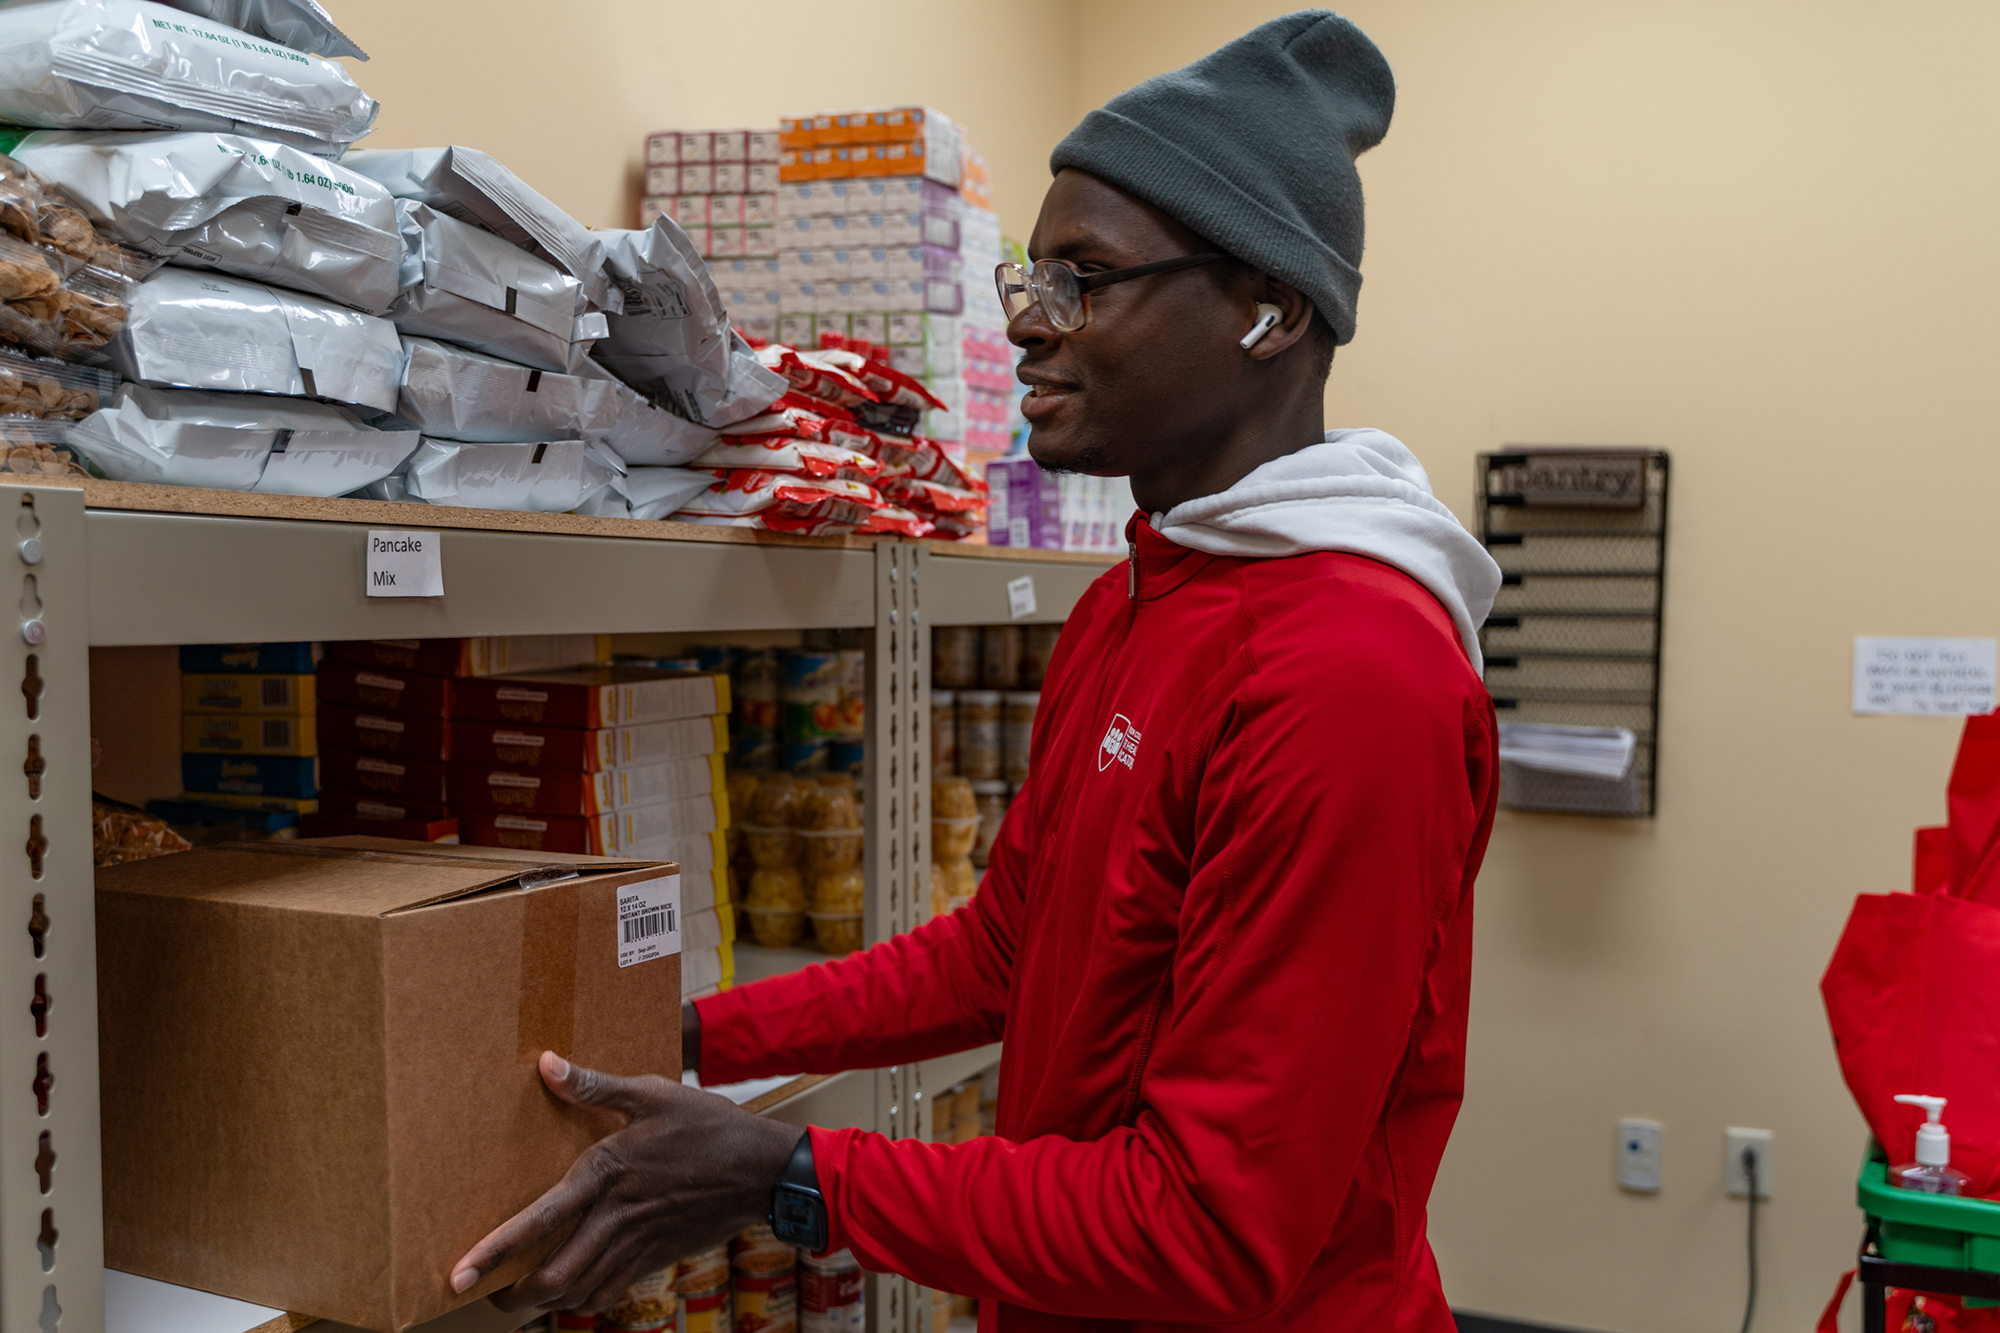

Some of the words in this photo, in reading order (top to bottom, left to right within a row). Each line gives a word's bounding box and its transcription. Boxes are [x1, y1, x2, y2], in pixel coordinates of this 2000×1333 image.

[152, 19, 172, 30] NET
[192, 29, 218, 42] 17.64
[218, 34, 231, 45] OZ
[252, 43, 271, 55] 1.64
[271, 49, 287, 61] OZ)
[288, 52, 309, 66] 500g
[296, 172, 315, 185] 1.64
[318, 176, 332, 191] OZ)
[373, 536, 422, 553] Pancake
[373, 570, 396, 586] Mix
[619, 895, 639, 906] SARITA
[638, 900, 647, 908] OZ
[620, 910, 641, 920] INSTANT
[641, 905, 659, 915] BROWN
[660, 902, 673, 910] RICE
